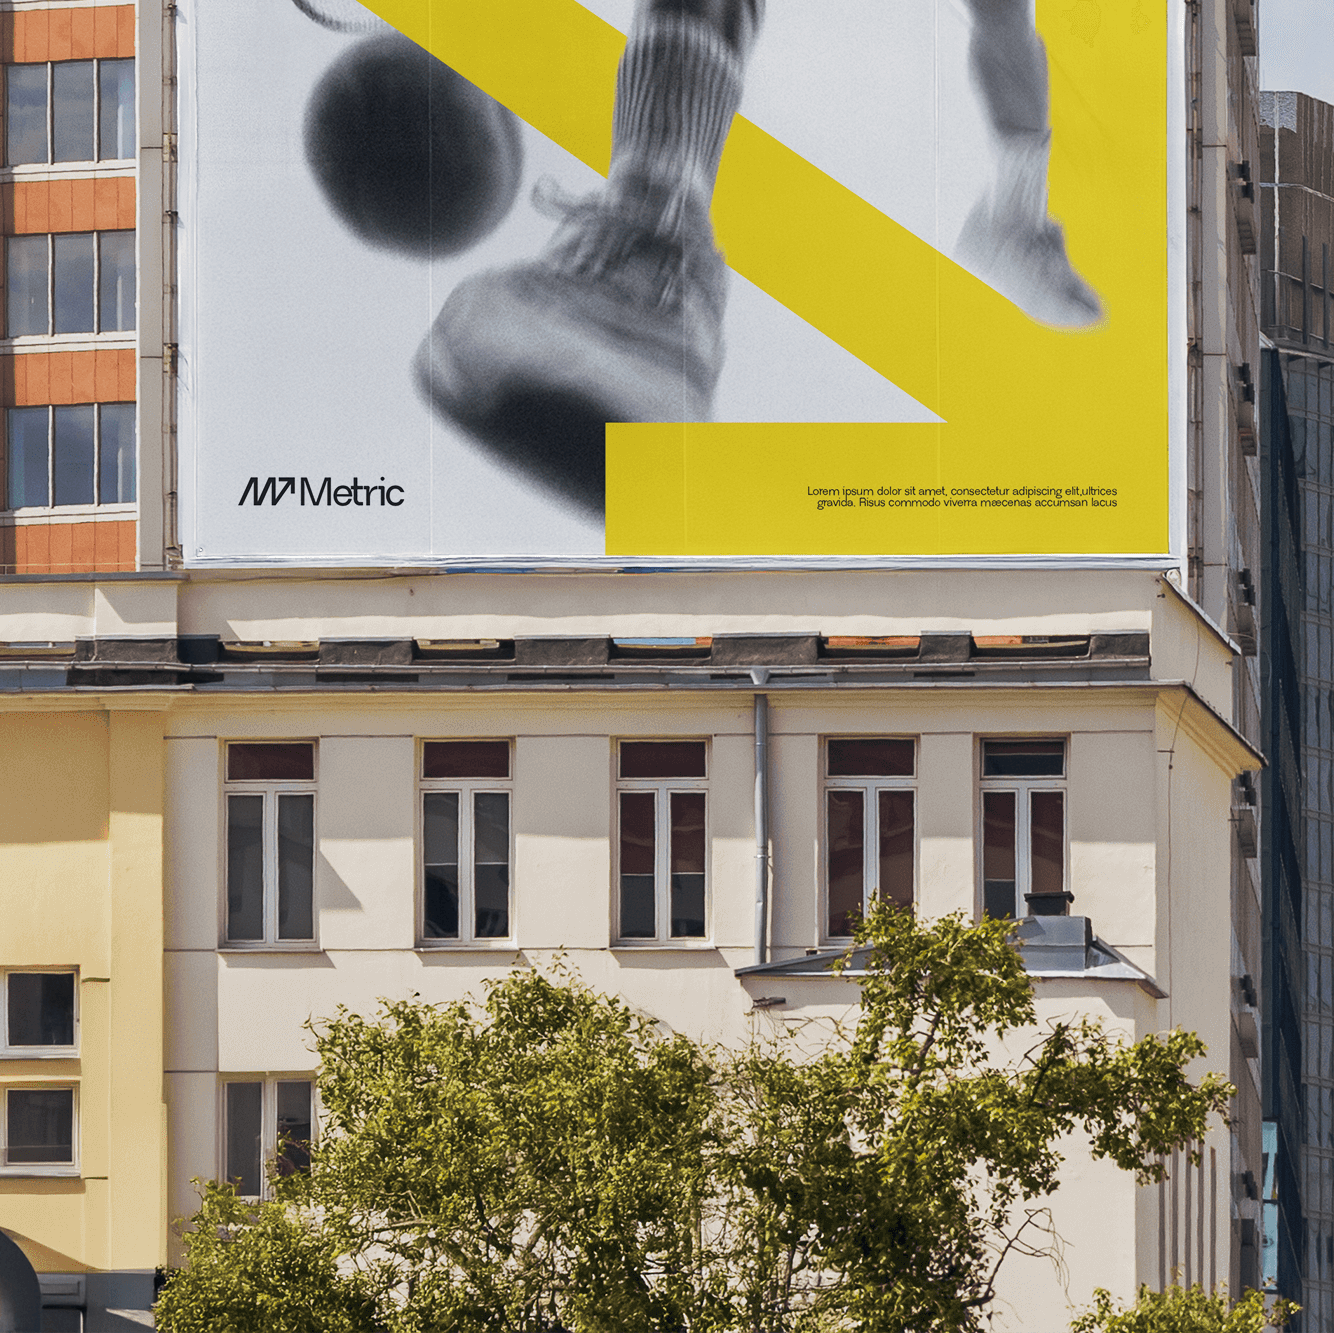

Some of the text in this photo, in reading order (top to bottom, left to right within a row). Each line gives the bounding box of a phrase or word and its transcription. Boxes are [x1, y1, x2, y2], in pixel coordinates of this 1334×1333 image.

[300, 476, 405, 507] Metric
[807, 485, 840, 496] Lorem
[842, 485, 874, 500] ipsum
[876, 485, 902, 496] dolor
[904, 485, 916, 496] sit
[918, 485, 948, 497] amet,
[950, 485, 1010, 496] consectetur
[1012, 485, 1063, 499] adipiscing
[816, 497, 856, 511] gravida.
[859, 497, 886, 507] Risus
[888, 497, 941, 507] commodo
[943, 497, 978, 507] viverra
[1034, 499, 1088, 507] accumsan
[1091, 497, 1118, 507] lacus
